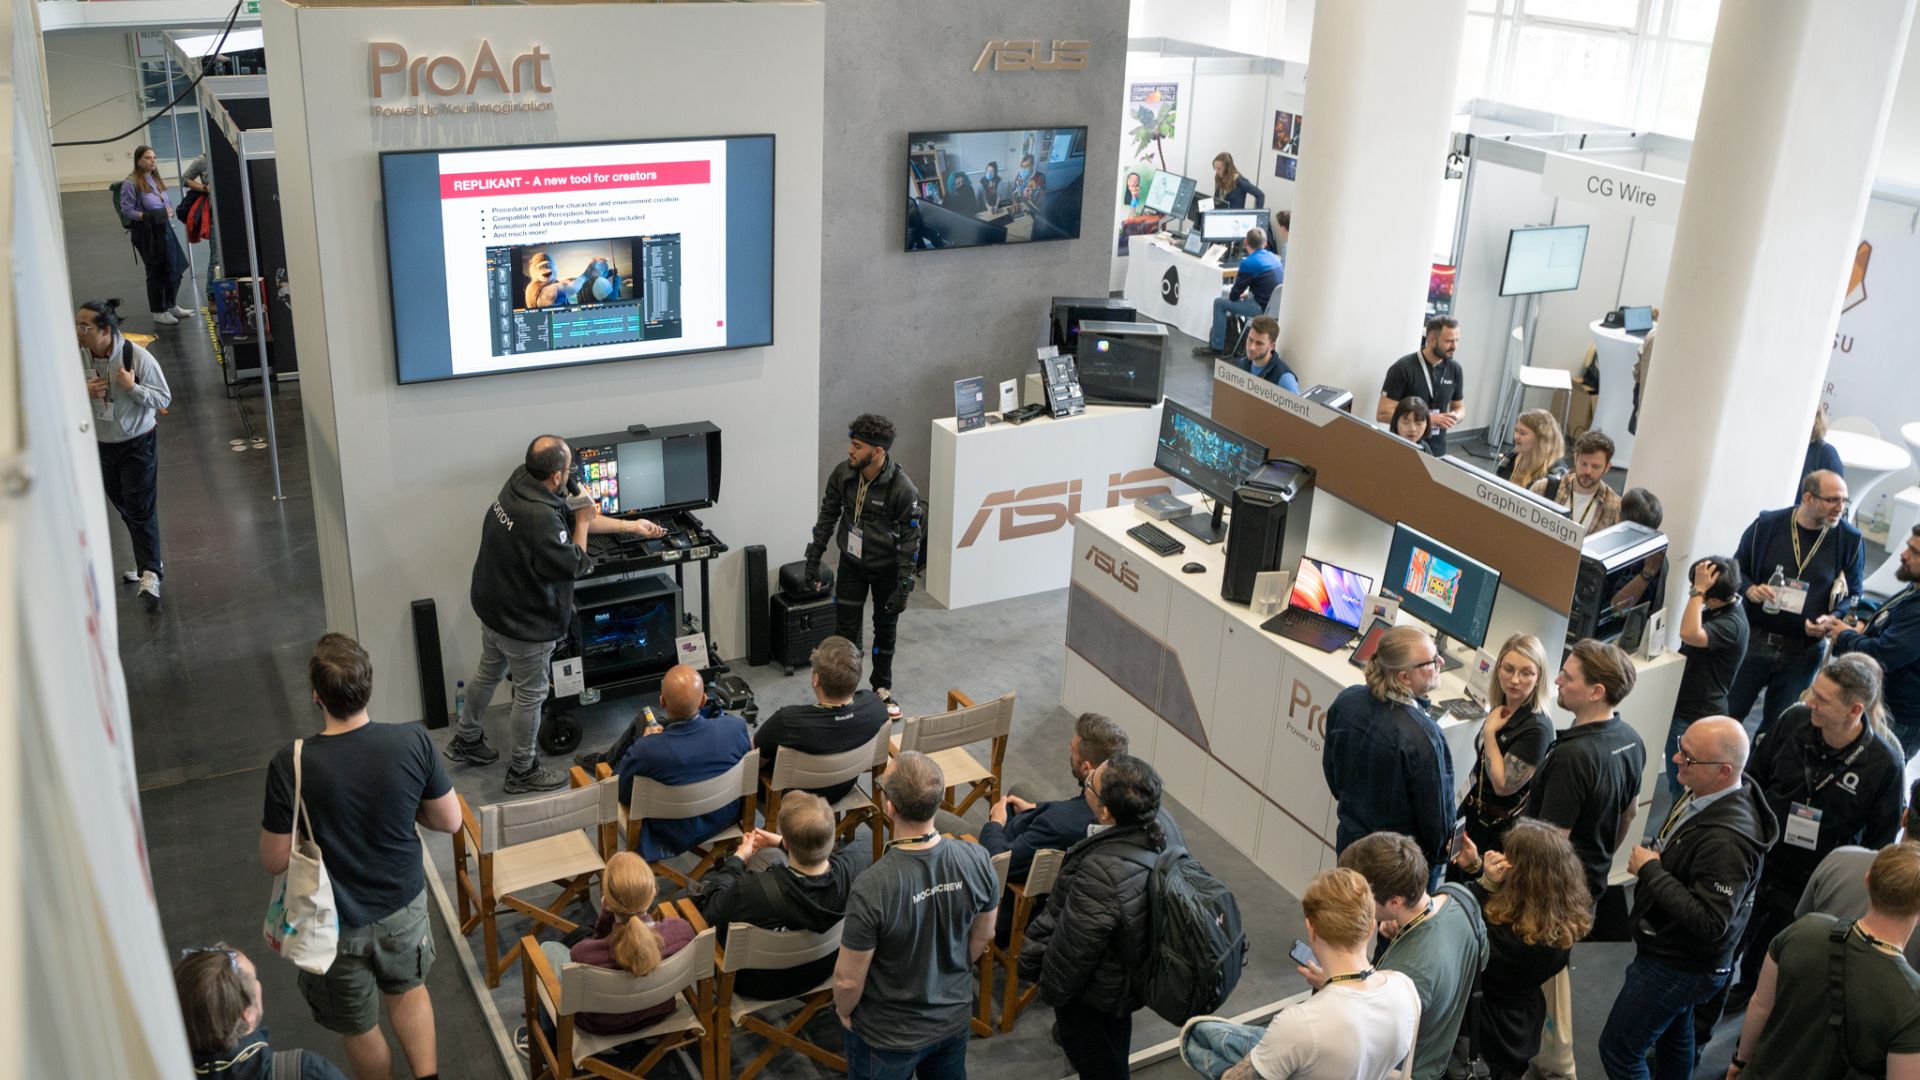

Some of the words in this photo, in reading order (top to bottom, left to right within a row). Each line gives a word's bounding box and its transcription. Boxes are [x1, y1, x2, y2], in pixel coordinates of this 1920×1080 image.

[370, 39, 553, 98] ProArt
[972, 40, 1090, 72] ASUS
[374, 103, 418, 118] Power
[420, 102, 440, 117] Up
[445, 103, 473, 114] Your
[475, 100, 554, 116] Imagination
[454, 177, 522, 191] REPLIKANT
[533, 176, 541, 186] A
[544, 175, 567, 186] new
[570, 173, 591, 184] tool
[593, 172, 609, 183] for
[612, 171, 657, 182] creators
[1587, 176, 1613, 197] CG
[1620, 181, 1656, 207] Wire
[492, 205, 528, 213] Procedural
[530, 204, 554, 212] system
[566, 201, 597, 209] character
[612, 198, 652, 206] environment
[492, 214, 531, 222] Compatible
[548, 210, 584, 218] Perception
[493, 222, 527, 230] Animation
[564, 217, 599, 226] production
[1218, 365, 1245, 387] Game
[1247, 378, 1310, 417] Development
[1476, 483, 1527, 519] Graphic
[1530, 509, 1577, 542] Design
[1085, 545, 1140, 593] ASUS
[1286, 721, 1309, 743] Power
[1310, 737, 1321, 752] Up
